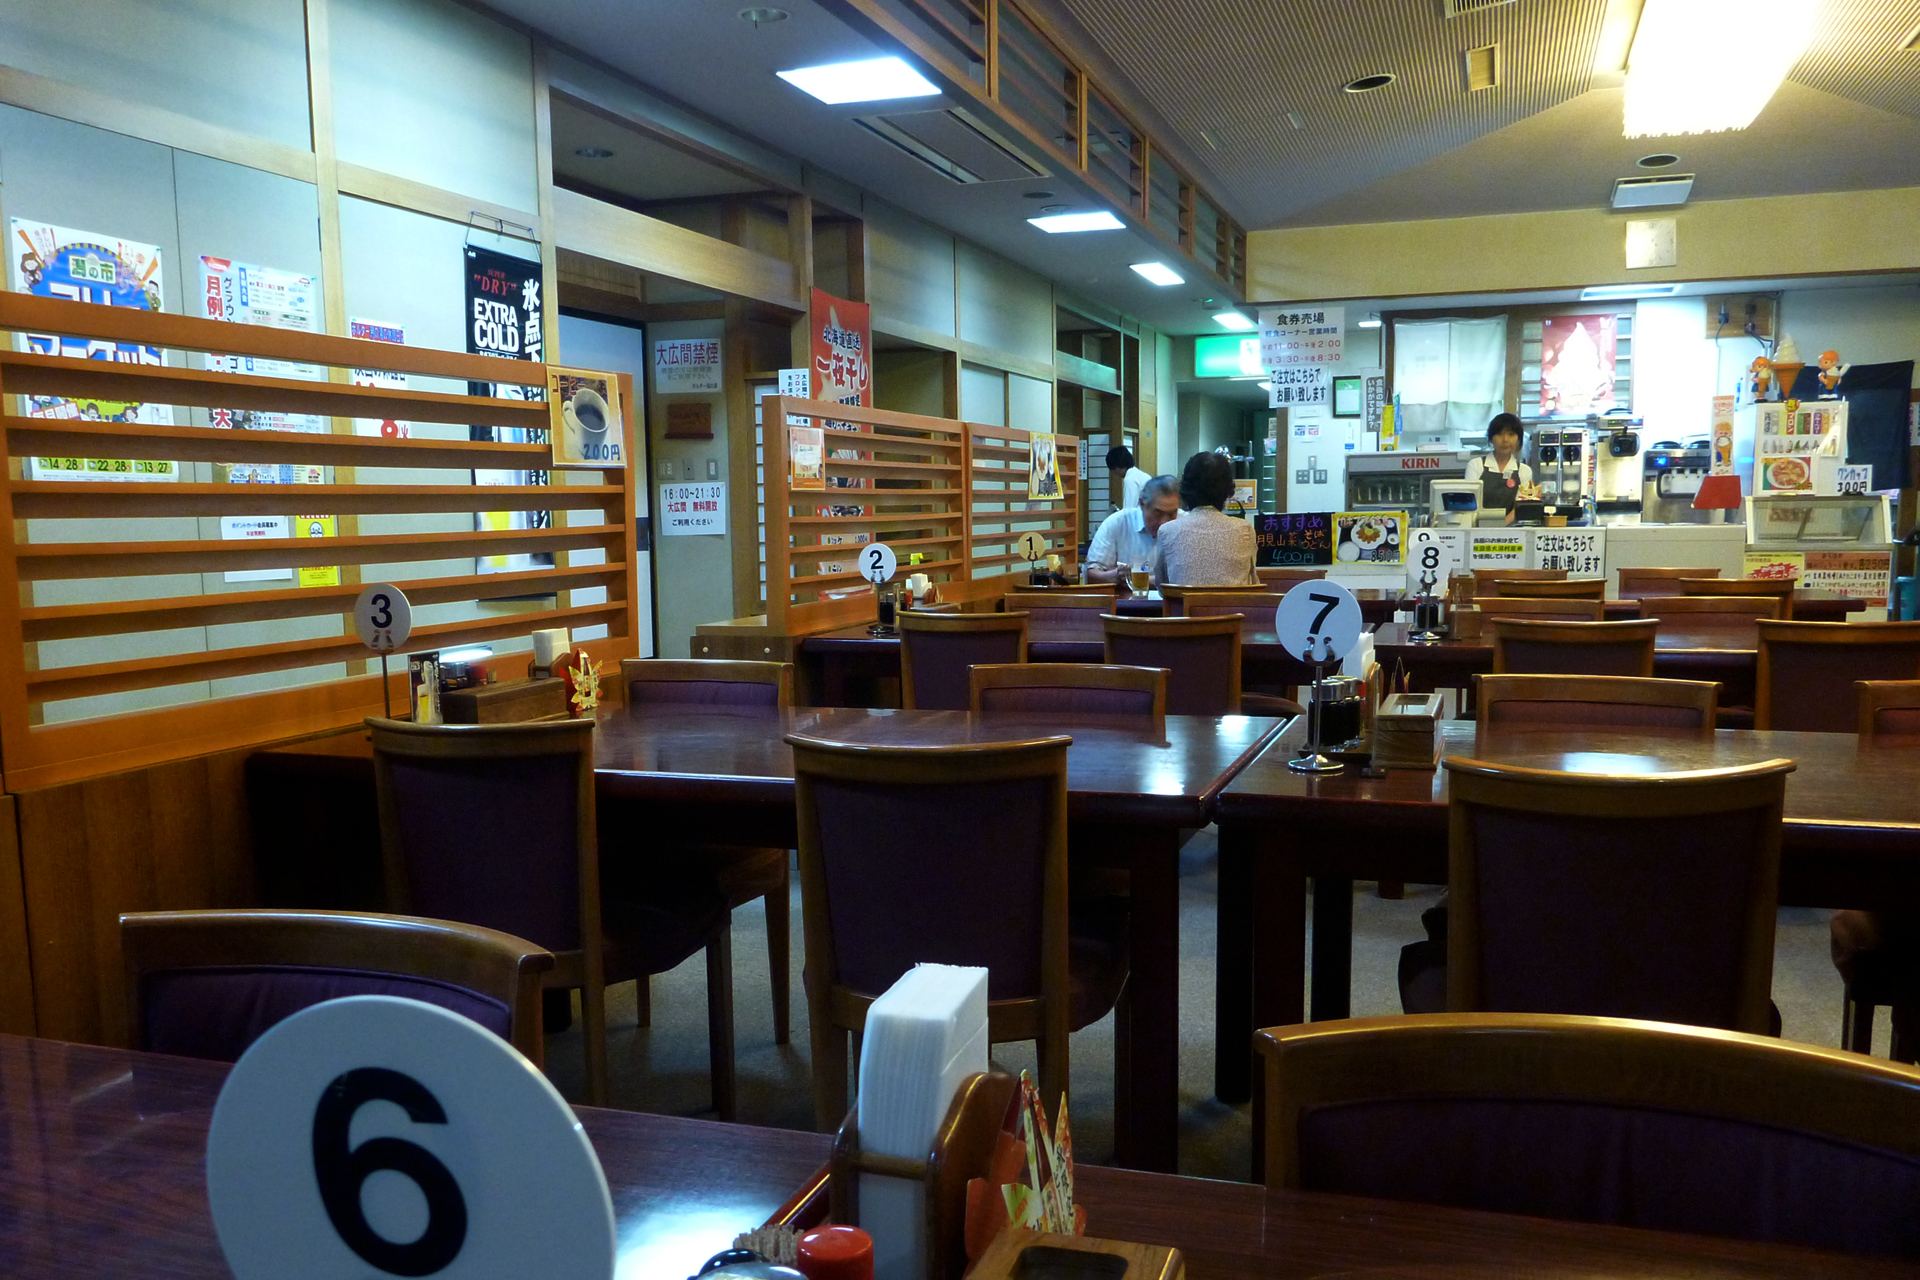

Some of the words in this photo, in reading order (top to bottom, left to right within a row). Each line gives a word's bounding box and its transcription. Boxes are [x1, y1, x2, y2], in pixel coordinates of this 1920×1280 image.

[473, 297, 518, 328] EXTRA
[1276, 312, 1325, 326] 食券売場
[474, 319, 519, 348] COLD
[823, 326, 861, 351] 北海道直送
[1265, 327, 1338, 338] 軽食コーナー営業時間
[656, 342, 719, 366] 大広間禁煙
[816, 352, 868, 390] 一夜干し
[1271, 368, 1321, 384] ご注文はこちらで
[1276, 386, 1327, 403] お願い致します
[1367, 380, 1375, 429] いかがですか?
[214, 408, 231, 428] 大
[583, 443, 620, 461] 200円
[48, 458, 60, 470] 14
[66, 459, 78, 470] 28
[97, 460, 109, 472] 22
[115, 461, 126, 472] 28
[143, 462, 152, 473] 13
[158, 463, 168, 474] 27
[1402, 458, 1440, 469] KIRIN
[1837, 481, 1867, 492] 300円
[667, 501, 687, 513] 大広間
[672, 518, 713, 527] ご利用ください
[1264, 516, 1324, 531] おすすめ
[1026, 537, 1033, 550] 1
[1256, 532, 1298, 547] 月見山菜
[1536, 535, 1595, 552] ご注文はこちらで
[869, 550, 884, 570] 2
[1272, 549, 1314, 564] 400円
[1421, 546, 1439, 569] 8
[1542, 555, 1600, 572] お願い致します
[371, 594, 392, 629] 3
[1309, 593, 1340, 635] 7
[312, 1066, 468, 1278] 6
